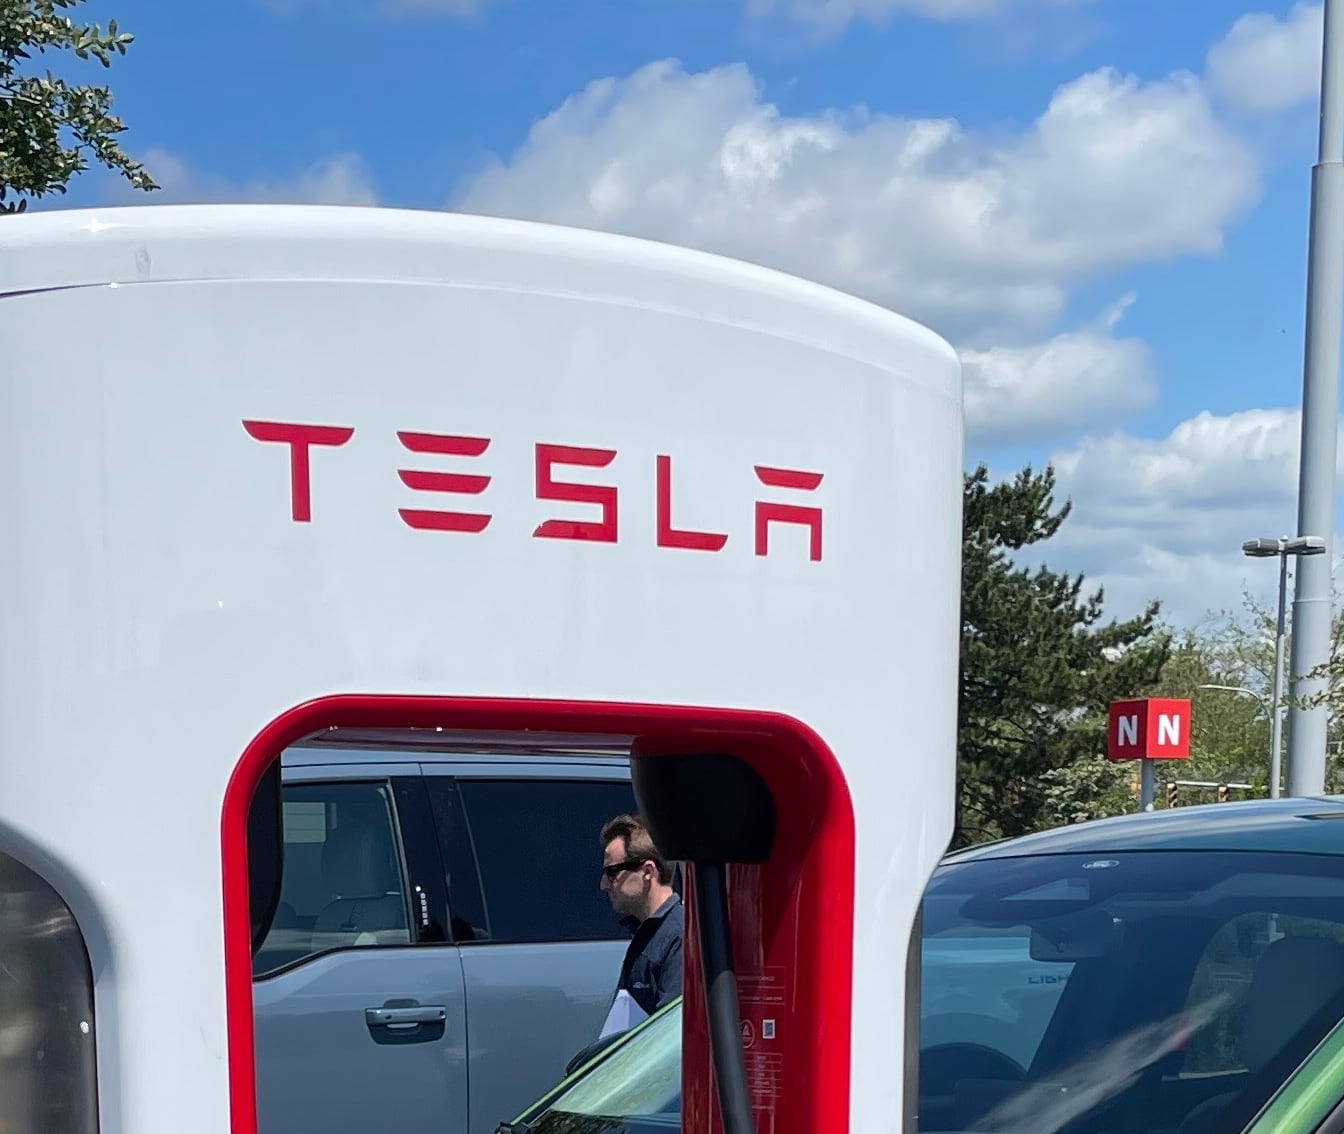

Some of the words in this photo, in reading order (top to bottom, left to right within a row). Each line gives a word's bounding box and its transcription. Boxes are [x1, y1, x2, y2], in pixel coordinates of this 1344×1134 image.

[242, 419, 824, 562] TESLA
[1118, 714, 1138, 747] N
[1157, 714, 1180, 746] N
